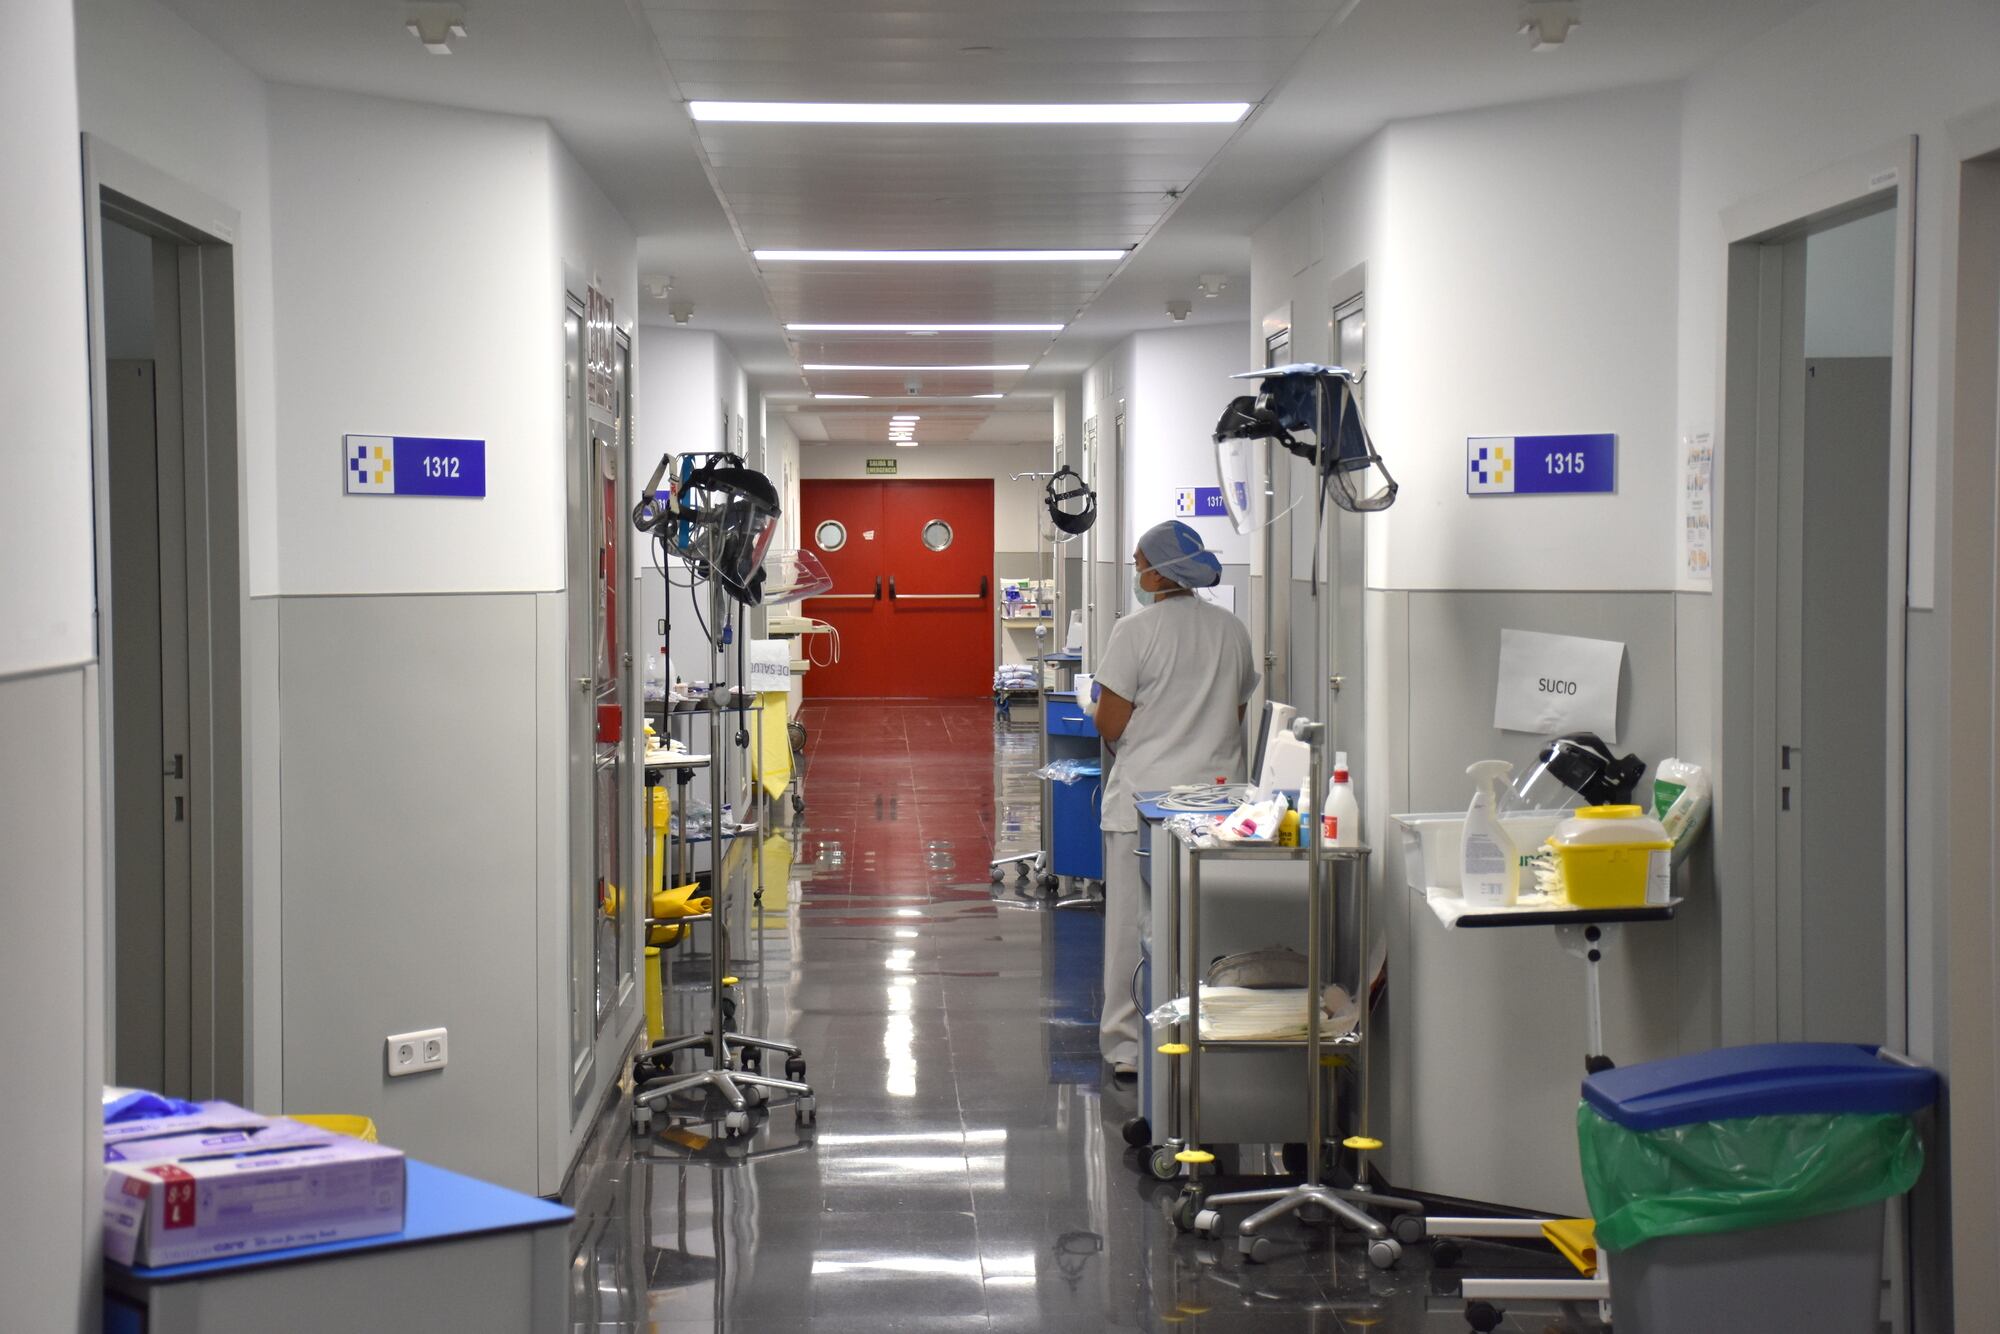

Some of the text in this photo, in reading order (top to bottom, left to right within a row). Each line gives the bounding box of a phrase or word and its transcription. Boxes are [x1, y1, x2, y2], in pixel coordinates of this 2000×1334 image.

[423, 456, 460, 478] 1312
[1545, 452, 1584, 474] 1315
[1207, 496, 1223, 507] 1317
[777, 664, 789, 676] DE
[1538, 678, 1577, 696] SUCIO
